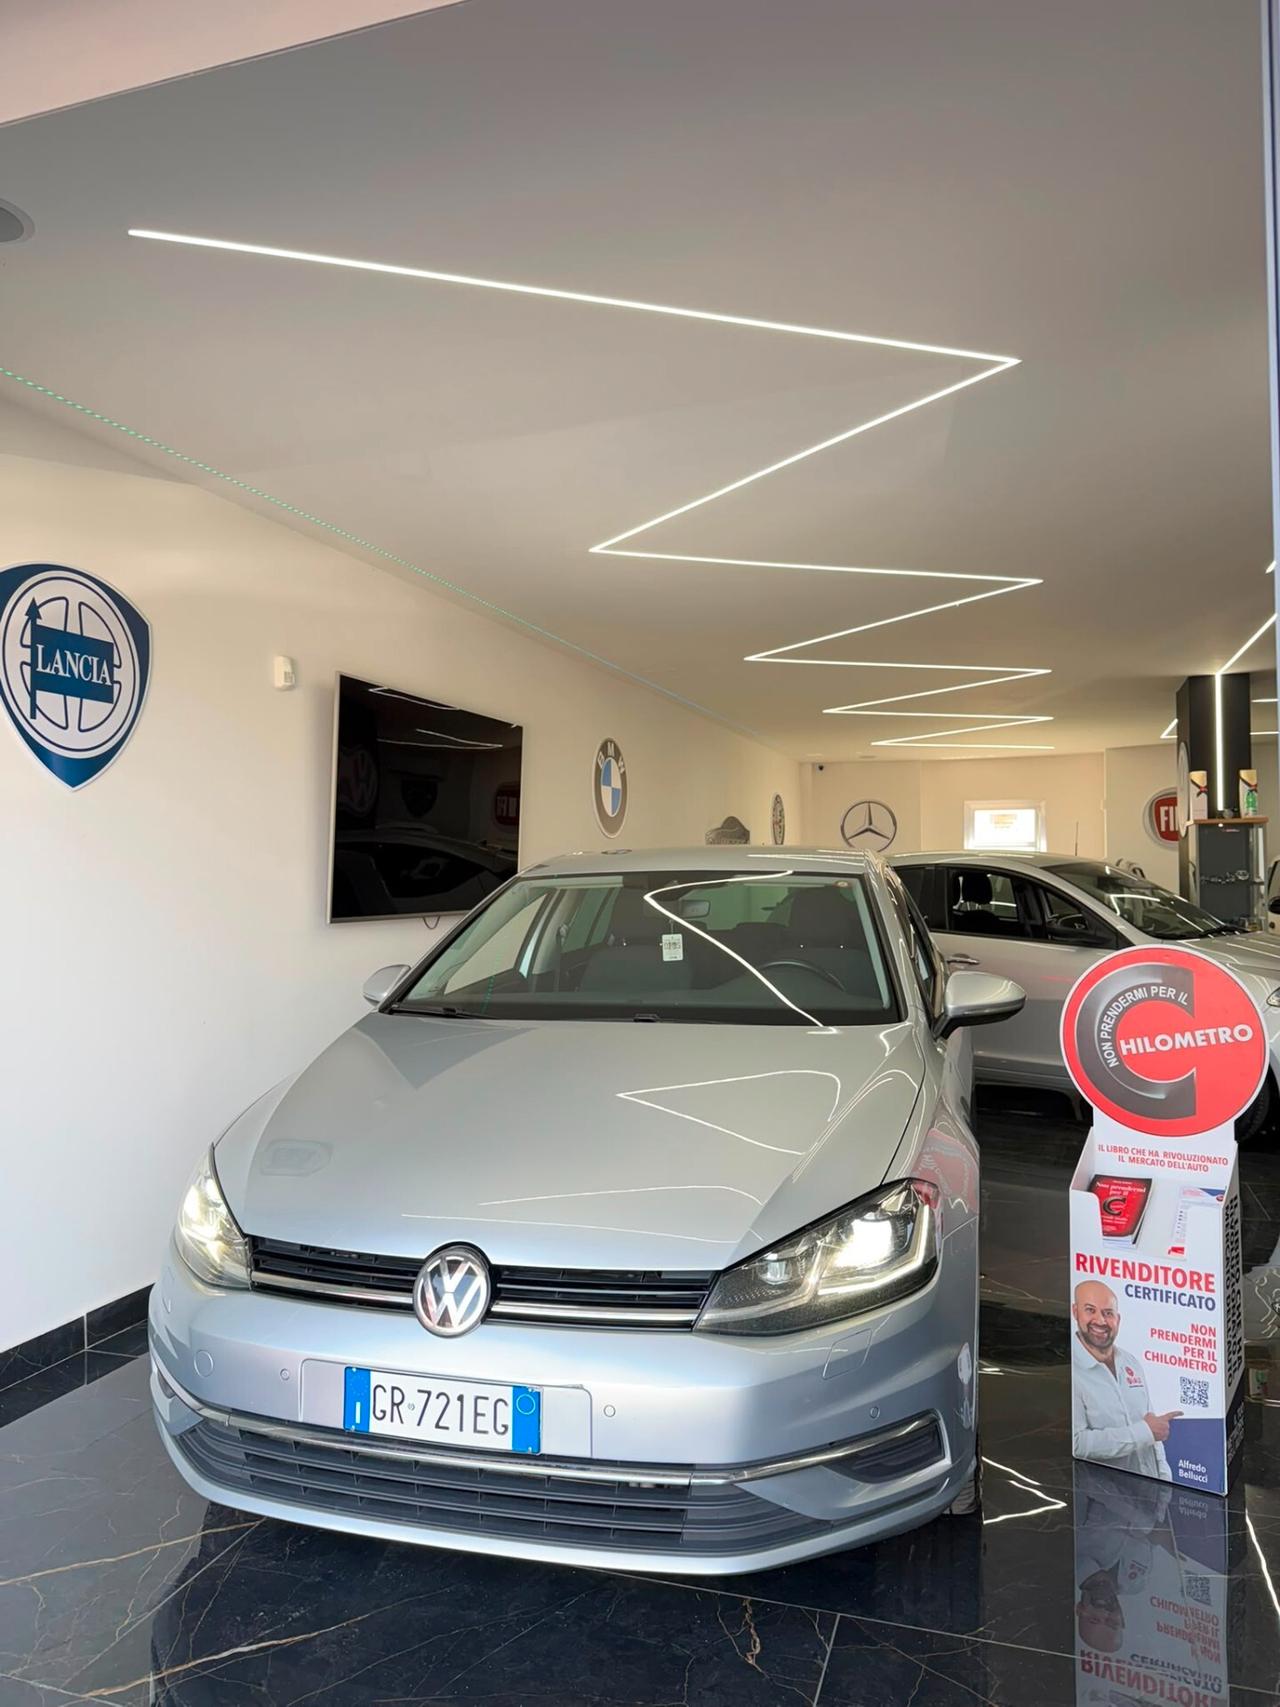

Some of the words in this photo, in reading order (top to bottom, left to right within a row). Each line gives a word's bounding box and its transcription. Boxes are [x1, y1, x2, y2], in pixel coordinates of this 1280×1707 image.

[36, 644, 112, 685] LANCIA
[1160, 806, 1179, 832] FI
[1150, 986, 1175, 1000] PER
[1178, 992, 1188, 1006] IL
[1101, 988, 1148, 1039] PRENDERMI
[1102, 1042, 1119, 1068] NON
[1098, 1144, 1105, 1153] IL
[1106, 1145, 1129, 1154] LIBRO
[1131, 1147, 1146, 1157] CHE
[1148, 1149, 1159, 1158] HA
[1163, 1151, 1228, 1166] RIVOLUZIONATO
[1118, 1155, 1125, 1163] IL
[1128, 1156, 1168, 1168] MERCATO
[1167, 1160, 1208, 1173] DELL'AUTO
[1075, 1253, 1216, 1293] RIVENDITORE
[1125, 1284, 1216, 1311] CERTIFICATO
[1150, 1328, 1217, 1349] PRENDERMI
[1191, 1323, 1217, 1338] NON
[1144, 1350, 1217, 1374] CHILOMETRO
[1183, 1346, 1204, 1359] PER
[1208, 1350, 1217, 1362] IL
[372, 1384, 405, 1425] GR
[416, 1389, 509, 1436] 721EG
[1178, 1460, 1207, 1473] Alfredo
[1178, 1469, 1208, 1483] Bellucci
